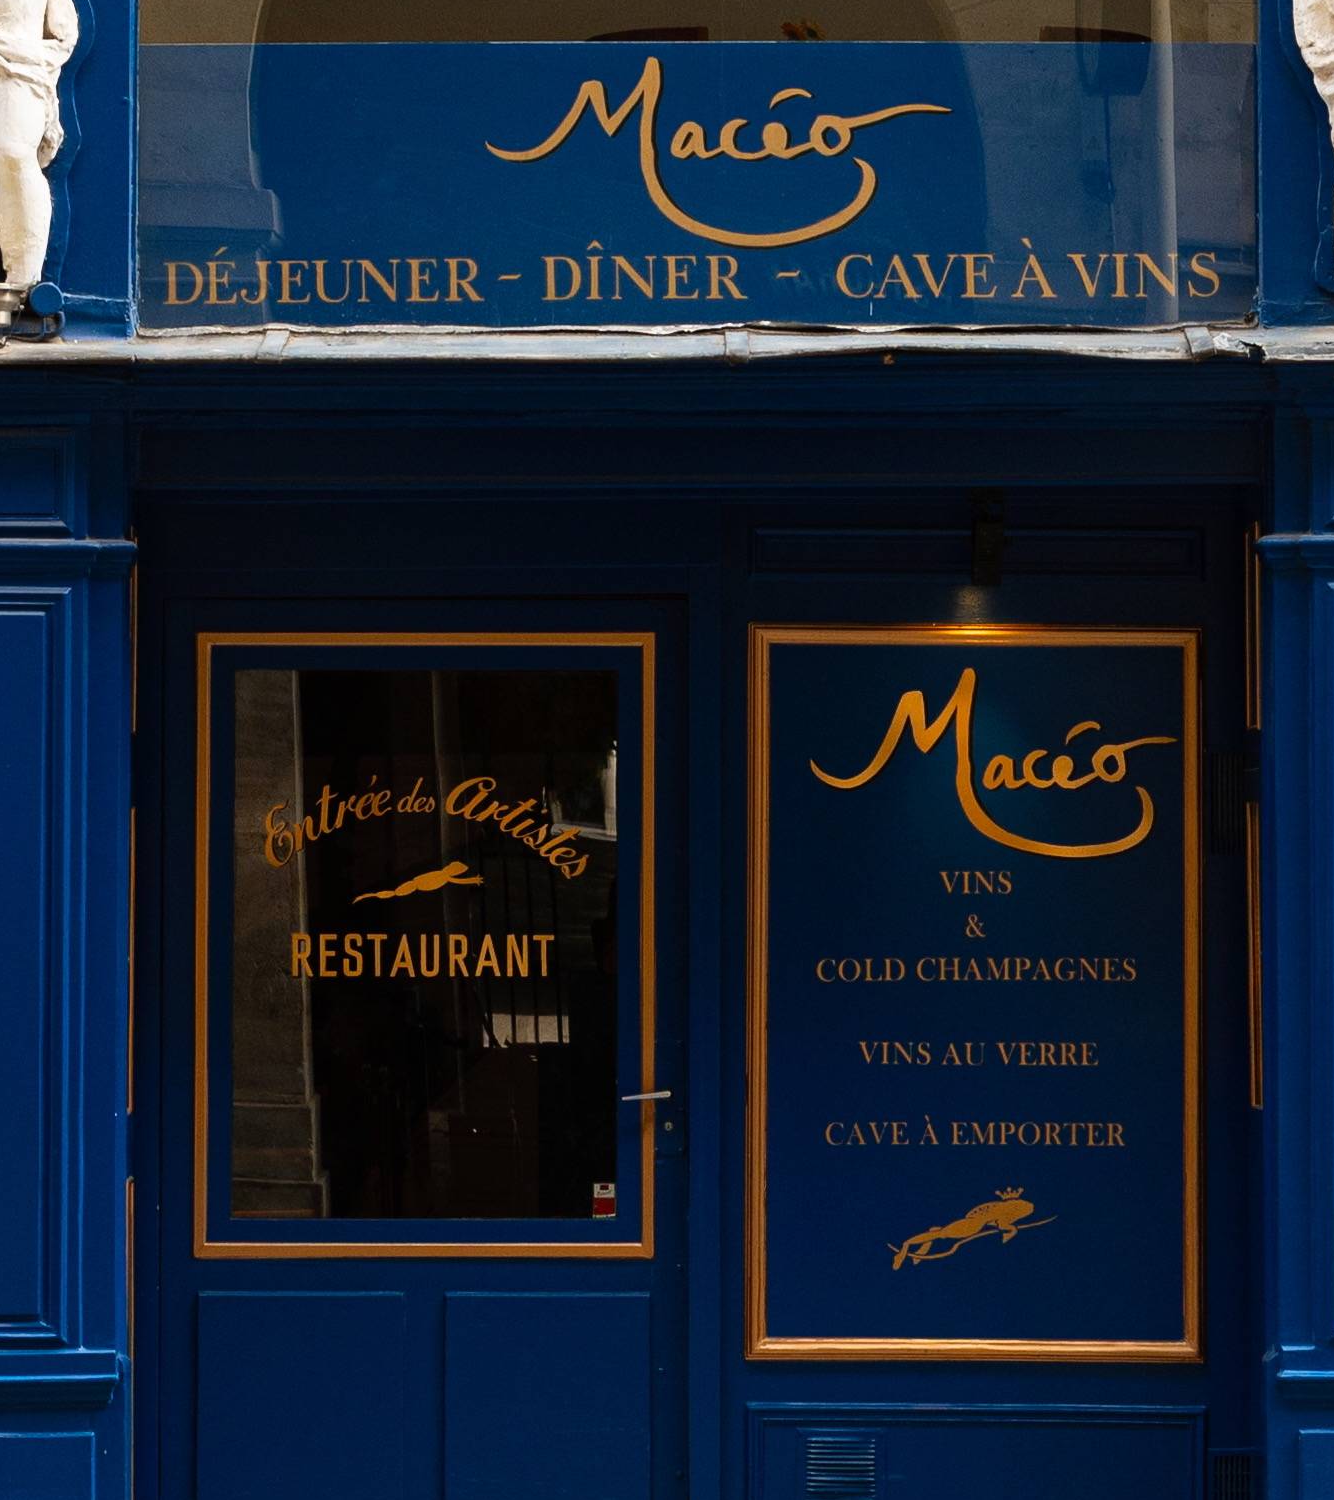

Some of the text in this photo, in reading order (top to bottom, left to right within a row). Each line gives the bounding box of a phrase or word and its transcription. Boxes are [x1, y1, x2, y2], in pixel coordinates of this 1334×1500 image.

[487, 56, 952, 248] Macéo
[163, 247, 485, 305] DÉJEUNER
[542, 240, 748, 300] DÎNER
[835, 253, 998, 299] CAVE
[1010, 237, 1058, 299] À
[1067, 251, 1221, 299] VINS
[809, 667, 1179, 859] Macéo
[263, 775, 590, 880] Entrée des Artistes
[938, 870, 1013, 895] VINS
[965, 913, 987, 938] &
[290, 930, 556, 978] RESTAURANT
[815, 956, 1138, 983] COLD CHAMPAGNES
[858, 1041, 1100, 1067] VINS AU VERRE
[824, 1113, 1127, 1147] CAVE À EMPORTER
